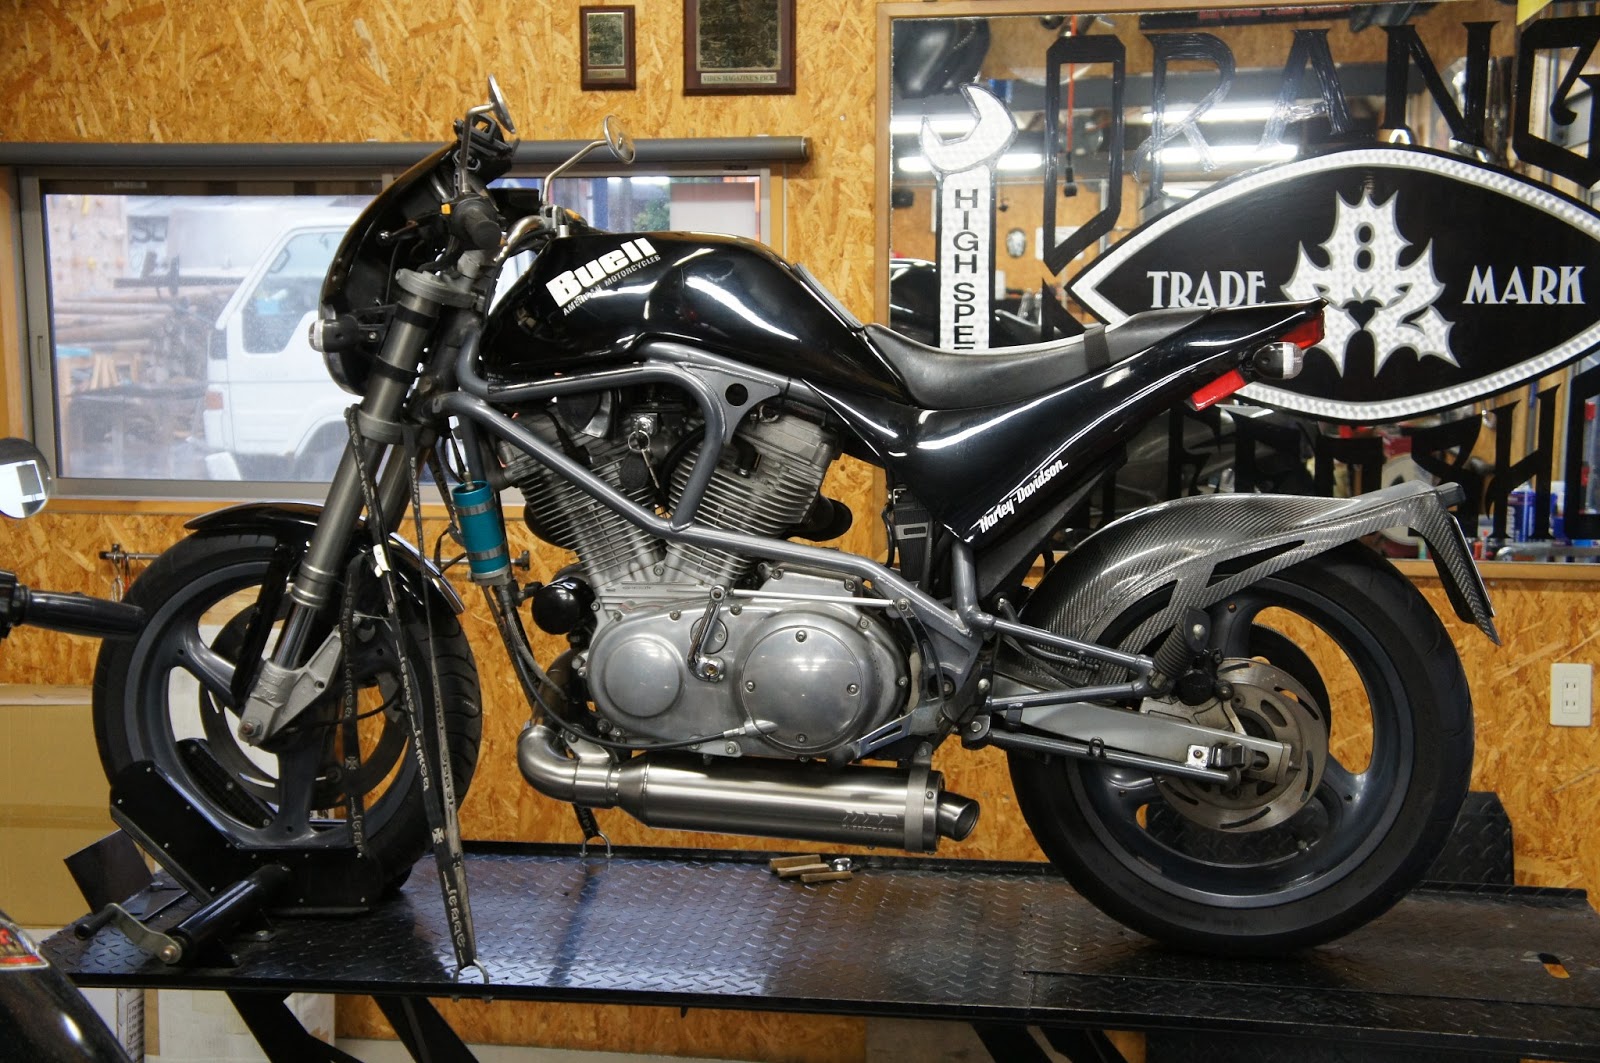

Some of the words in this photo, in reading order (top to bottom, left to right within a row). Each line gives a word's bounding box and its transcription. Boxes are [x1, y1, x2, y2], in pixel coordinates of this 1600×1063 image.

[953, 188, 979, 274] HIGH
[545, 237, 657, 308] Buell
[604, 254, 661, 287] MOTORCYCLES
[1146, 270, 1267, 309] TRADE
[1462, 264, 1587, 306] MARK
[953, 282, 976, 350] SPE
[979, 459, 1069, 534] Harley-Davidson
